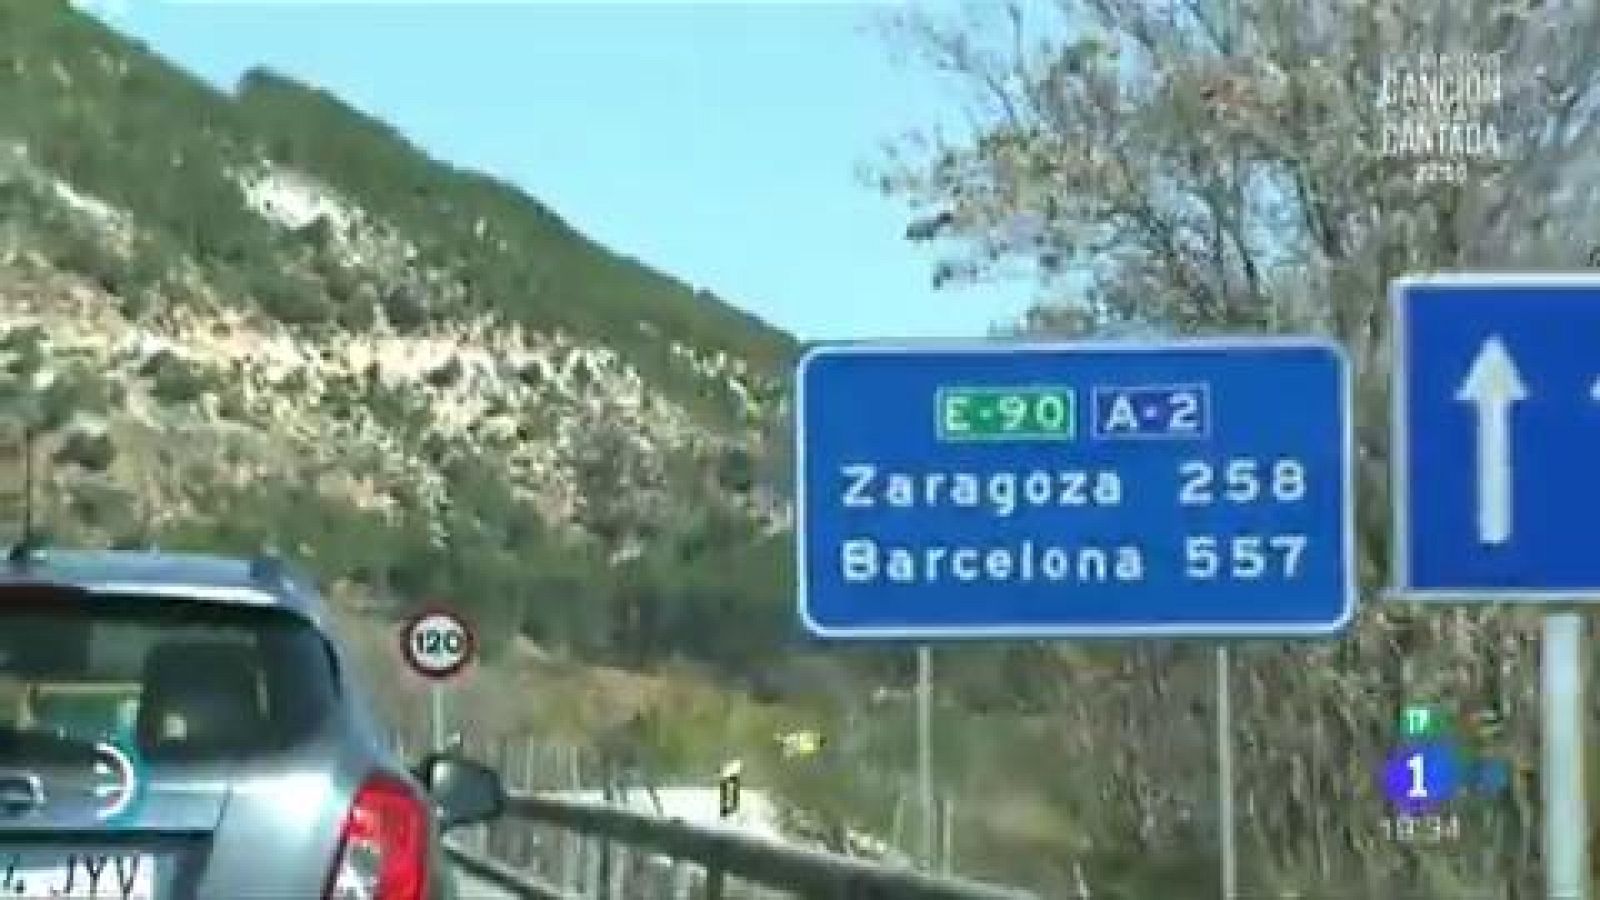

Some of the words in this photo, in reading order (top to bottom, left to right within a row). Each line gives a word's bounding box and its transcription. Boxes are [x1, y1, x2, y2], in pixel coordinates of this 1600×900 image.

[945, 395, 1065, 431] E-90
[1105, 395, 1199, 432] A-2
[841, 463, 1122, 515] Zaragoza
[1179, 460, 1306, 503] 258
[841, 537, 1144, 582] Barcelona
[1185, 536, 1307, 579] 557
[416, 629, 463, 654] 120
